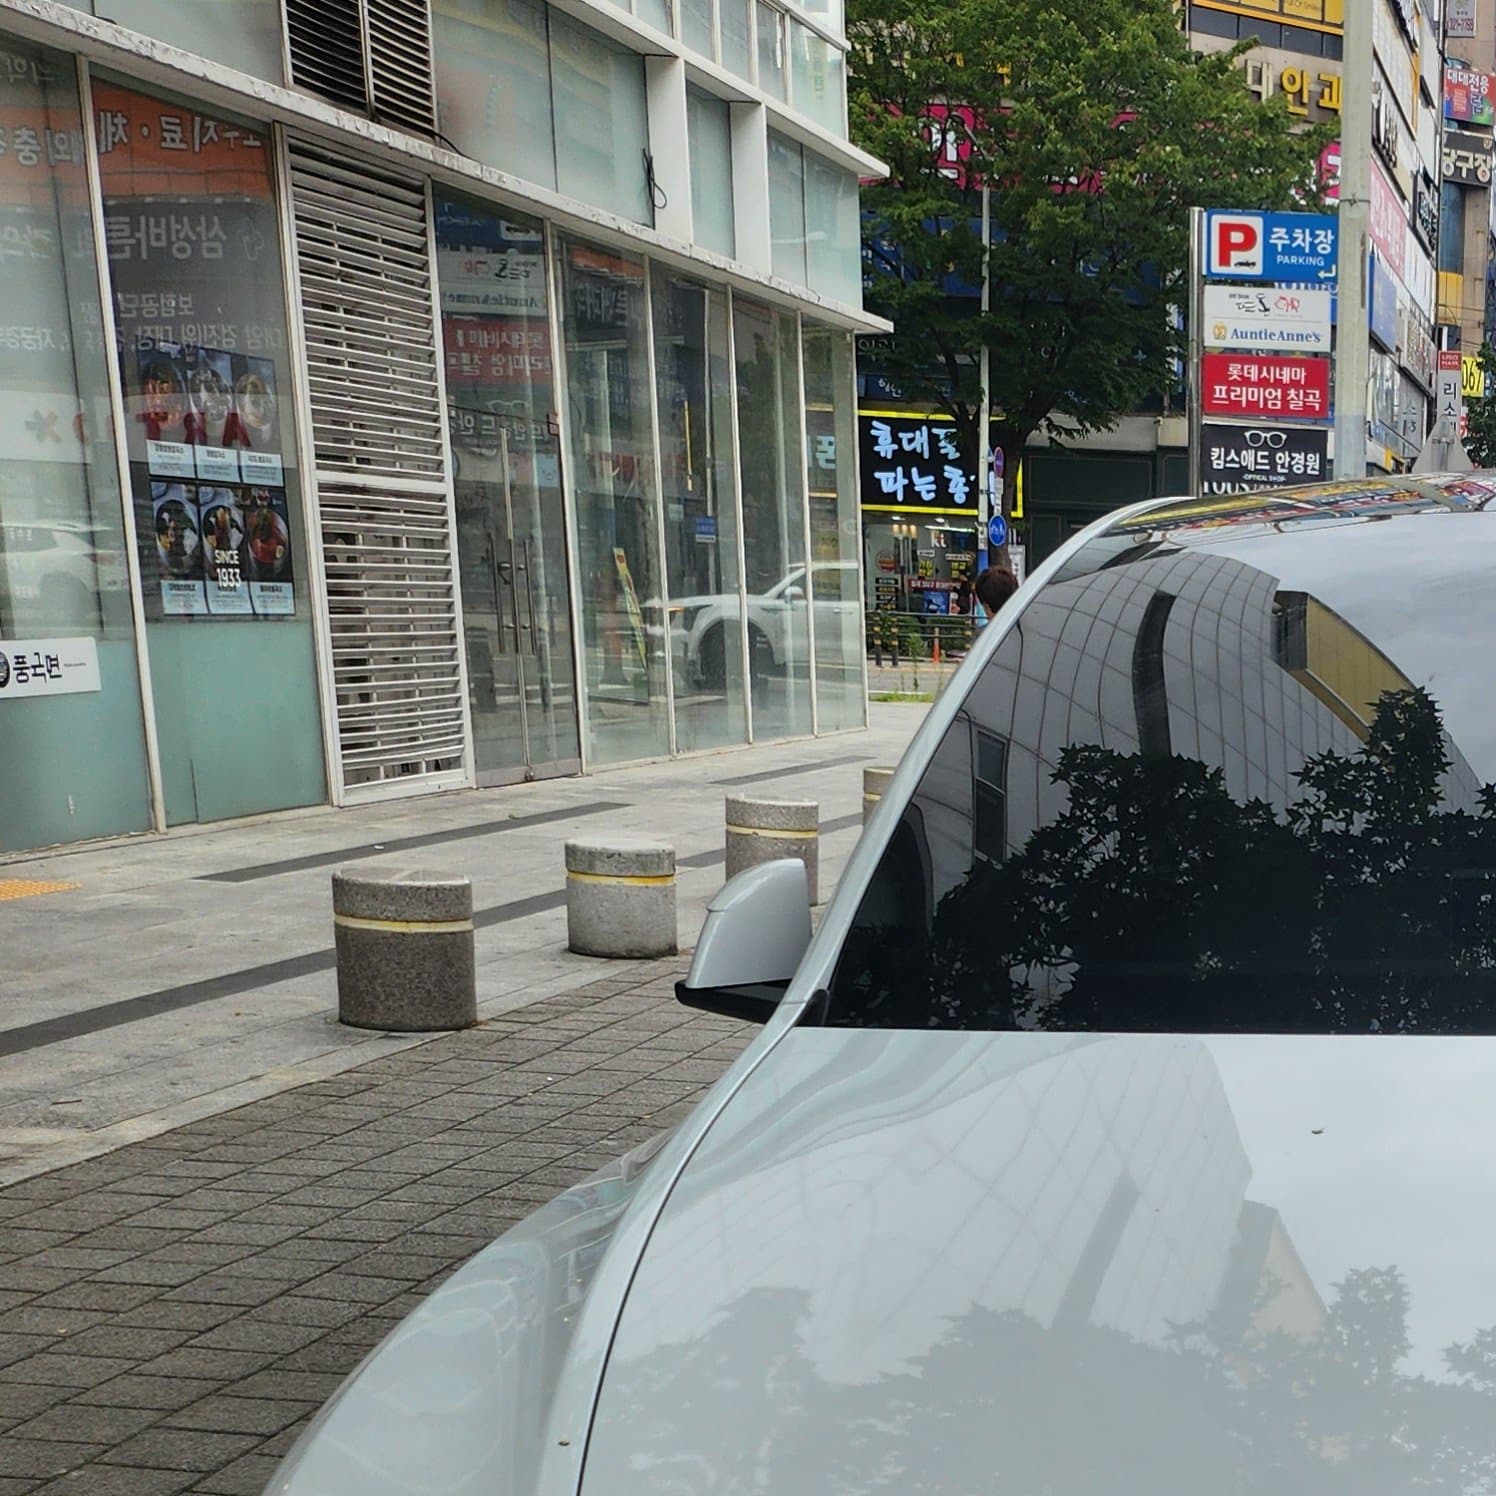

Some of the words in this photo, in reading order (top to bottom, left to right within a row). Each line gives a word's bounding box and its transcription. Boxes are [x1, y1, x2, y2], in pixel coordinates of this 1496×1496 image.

[1443, 148, 1492, 183] 당구장
[1218, 222, 1257, 267] P
[1269, 227, 1335, 254] 주차장
[1276, 255, 1325, 267] PARKING
[1227, 363, 1306, 386] 롯데시네마
[1212, 387, 1281, 410] 프리미엄
[1286, 389, 1321, 412] 칠곡
[1210, 447, 1270, 472] 킴스애드
[1275, 451, 1320, 475] 안경원
[874, 466, 936, 501] 파는
[214, 550, 239, 565] SINCE
[216, 568, 241, 588] 1933
[13, 652, 63, 684] 풍국면
